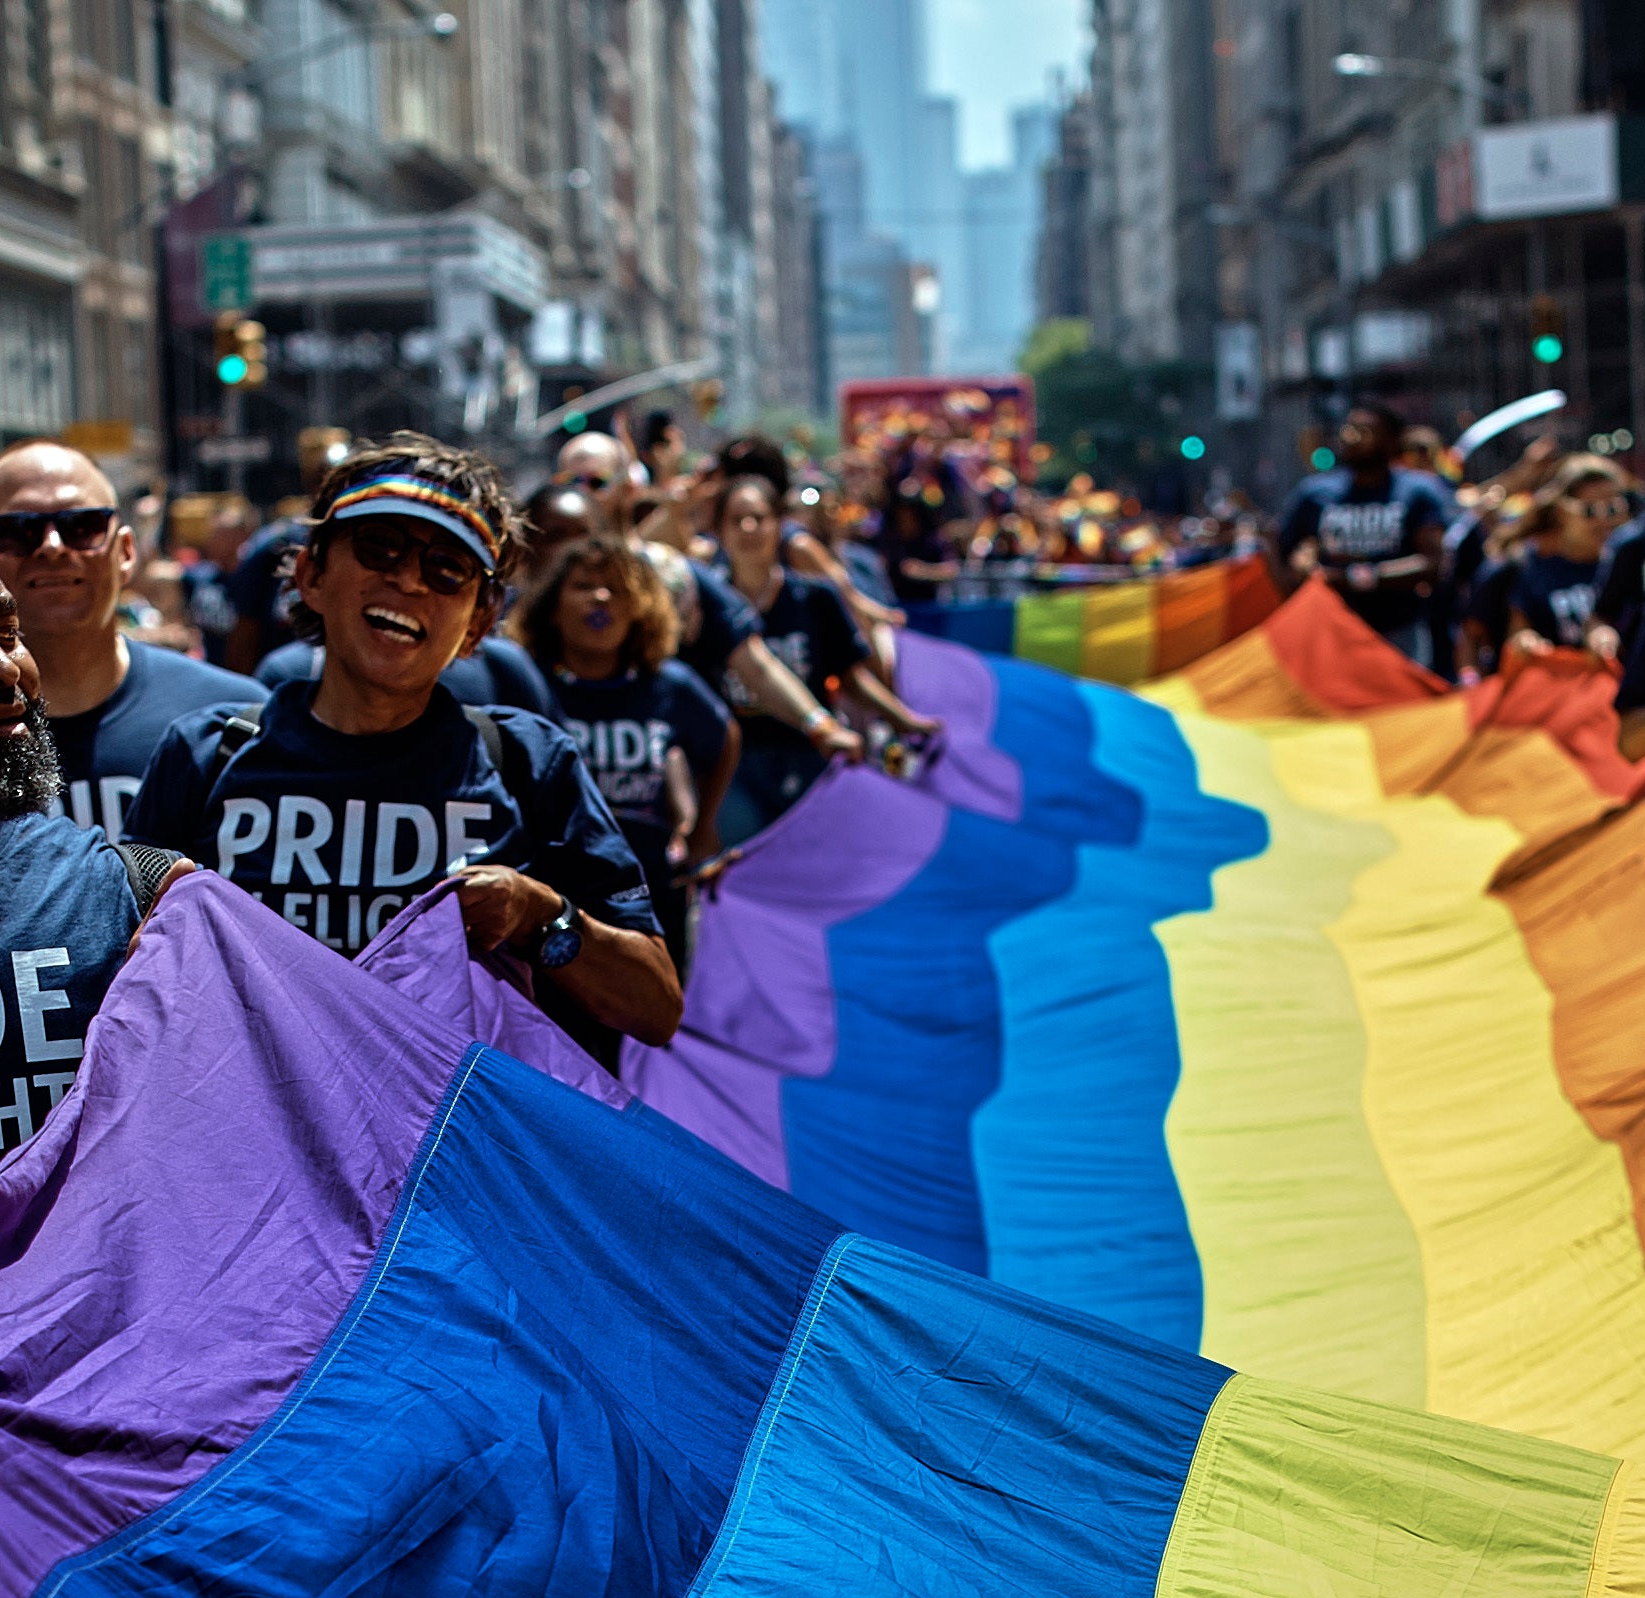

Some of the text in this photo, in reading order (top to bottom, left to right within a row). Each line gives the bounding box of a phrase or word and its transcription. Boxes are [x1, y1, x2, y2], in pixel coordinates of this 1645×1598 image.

[565, 719, 672, 771] RIDE
[217, 795, 492, 887] PRIDE
[282, 892, 422, 949] FLIG
